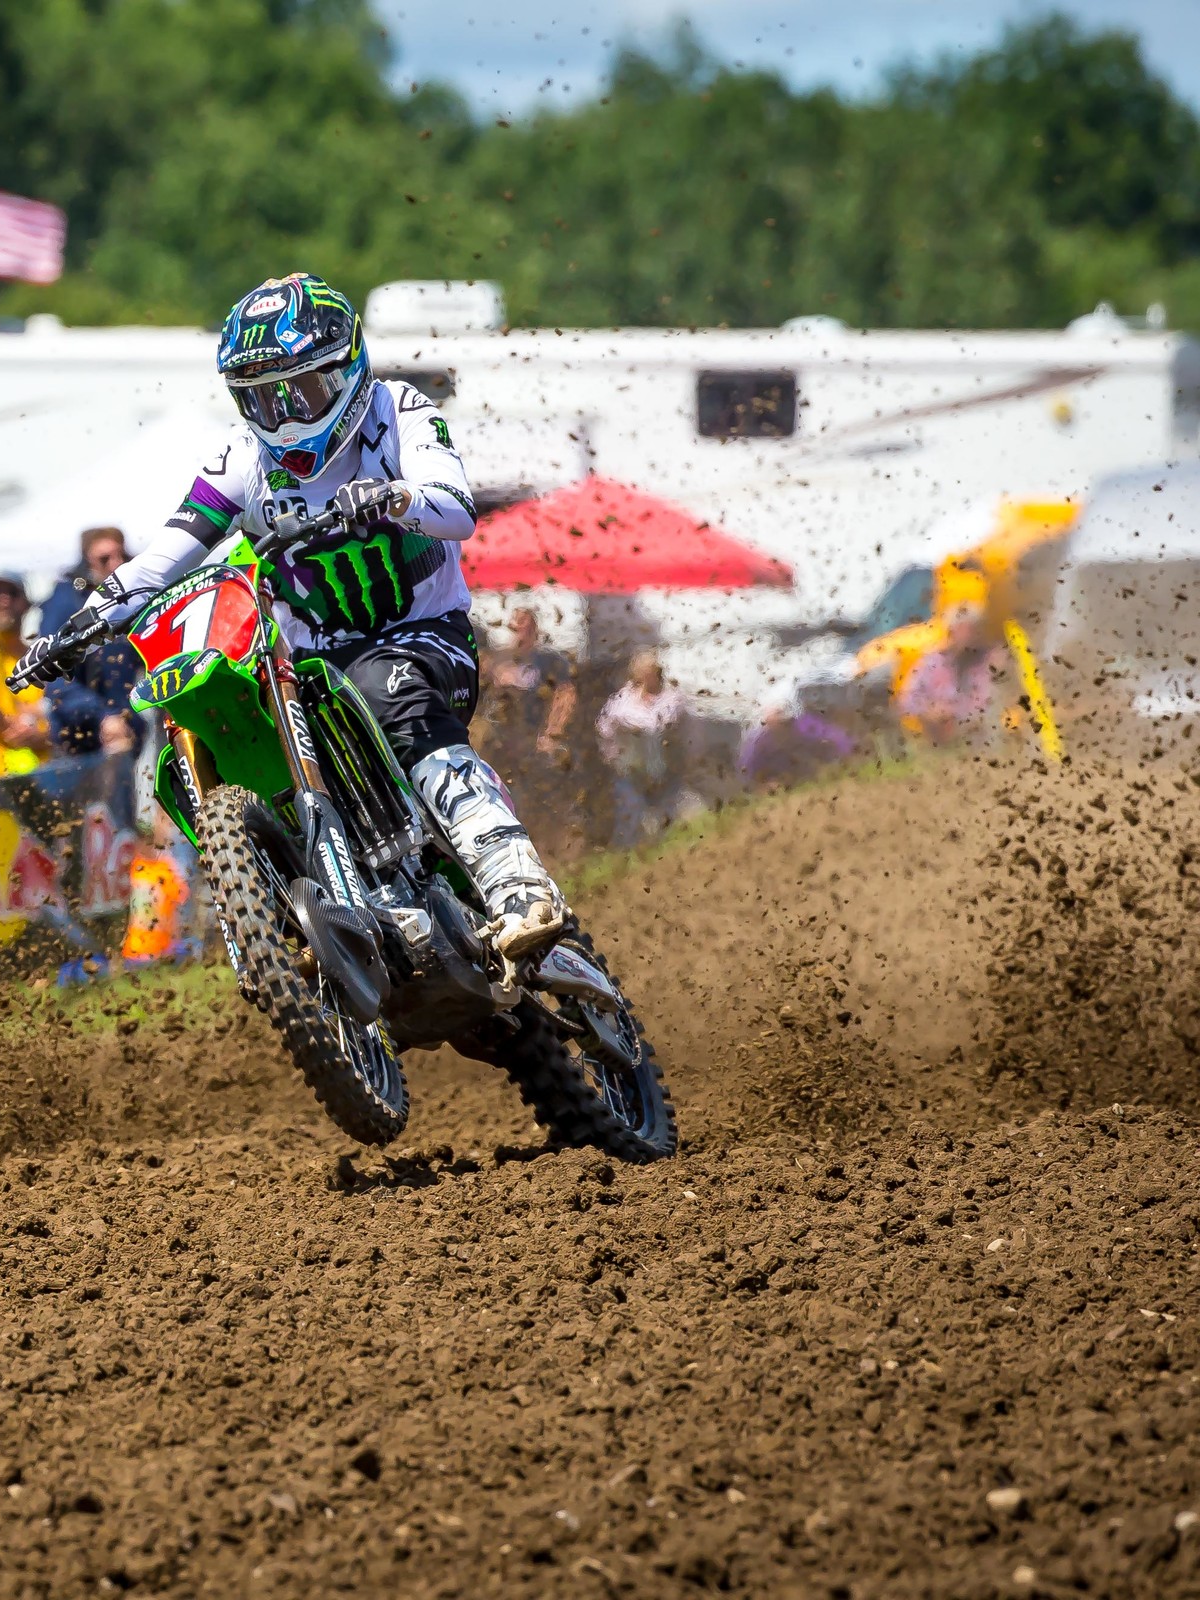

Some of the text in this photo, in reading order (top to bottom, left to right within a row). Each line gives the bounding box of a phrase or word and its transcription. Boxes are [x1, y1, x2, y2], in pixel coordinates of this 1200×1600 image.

[252, 301, 279, 312] BELL
[283, 436, 298, 445] BELL
[160, 577, 216, 613] LUCAS OIL
[171, 589, 218, 653] 1
[329, 827, 365, 908] DUNLOP
